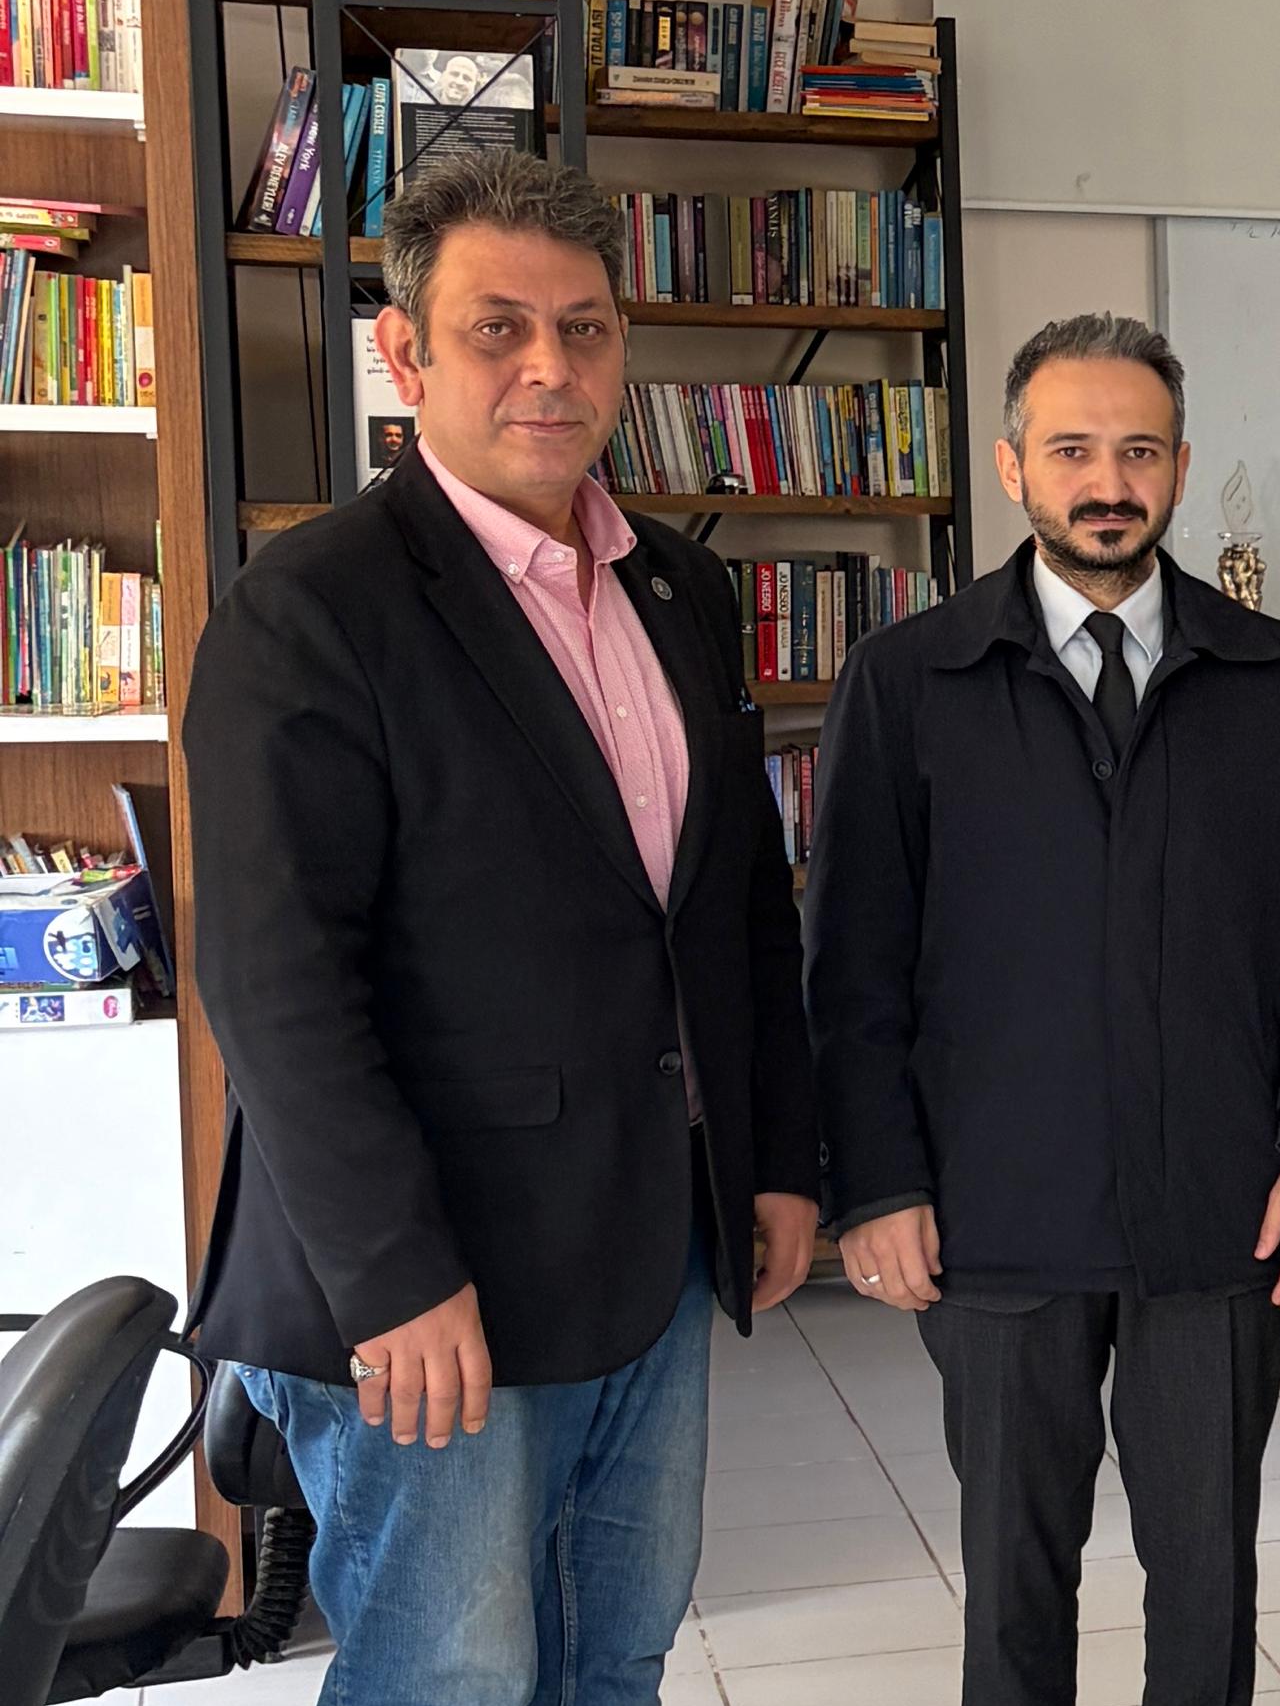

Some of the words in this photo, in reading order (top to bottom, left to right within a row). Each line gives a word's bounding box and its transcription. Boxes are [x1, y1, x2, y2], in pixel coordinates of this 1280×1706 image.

[375, 83, 385, 103] CLIVE
[374, 104, 385, 135] CUSSLER
[298, 148, 316, 171] York
[761, 568, 770, 580] JO
[779, 572, 788, 583] JO
